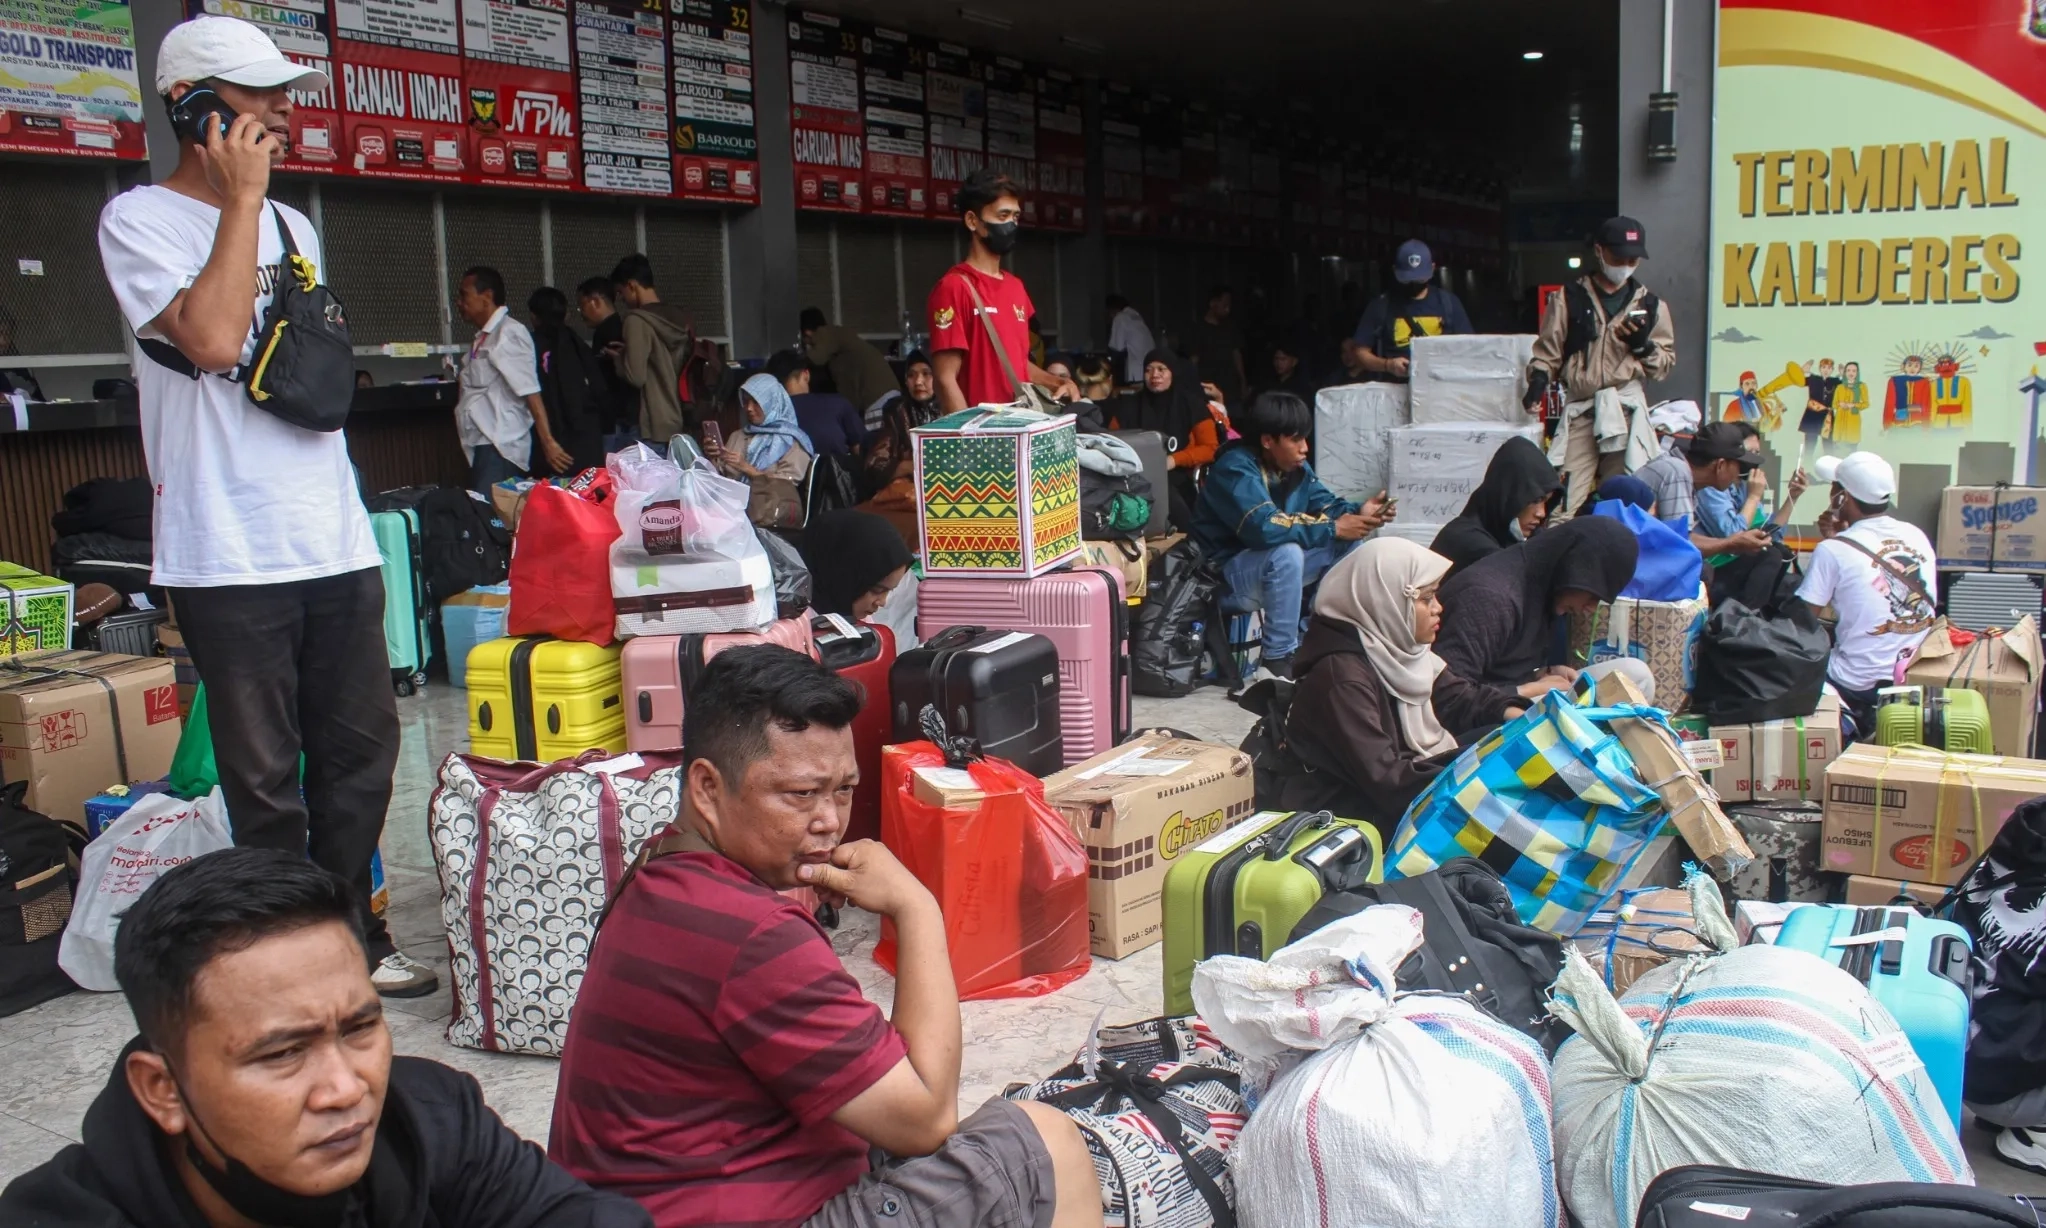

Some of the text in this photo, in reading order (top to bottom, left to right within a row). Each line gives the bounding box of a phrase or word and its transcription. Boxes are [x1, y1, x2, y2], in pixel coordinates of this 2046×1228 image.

[250, 5, 315, 28] PELANGI
[575, 15, 629, 34] DEWANTARA
[731, 6, 749, 29] 32
[672, 20, 710, 37] DAMRI
[44, 38, 134, 72] TRANSPORT
[579, 52, 610, 65] MAWAR
[36, 60, 60, 70] NIAGA
[673, 55, 722, 74] MEDALI MAS
[17, 89, 51, 100] SALATIGA
[342, 62, 463, 124] RANAU INDAH
[675, 82, 725, 100] BARXOLID
[45, 101, 73, 110] JOMBOR
[609, 97, 634, 111] TRANS
[582, 122, 615, 136] ANINDYA
[697, 132, 757, 149] BARXOLID
[793, 127, 839, 167] GARUDA
[839, 133, 863, 170] MAS
[19, 145, 59, 154] PEMESANAN
[61, 148, 79, 156] TIKET
[584, 153, 637, 169] ANTAR JAYA
[931, 146, 957, 181] RONA
[1732, 137, 2020, 218] TERMINAL
[1722, 233, 2022, 308] KALIDERES
[643, 515, 681, 525] Amanda
[1961, 496, 2038, 531] Sponge
[151, 684, 173, 710] 12
[152, 711, 176, 723] Batang
[1157, 782, 1195, 800] MAKANAN
[1755, 780, 1762, 792] 6
[1826, 835, 1872, 848] LIFEBUOY
[1843, 828, 1873, 838] SHISO
[1122, 931, 1140, 945] RASA
[1144, 923, 1159, 936] SAPI
[1184, 1034, 1197, 1057] the
